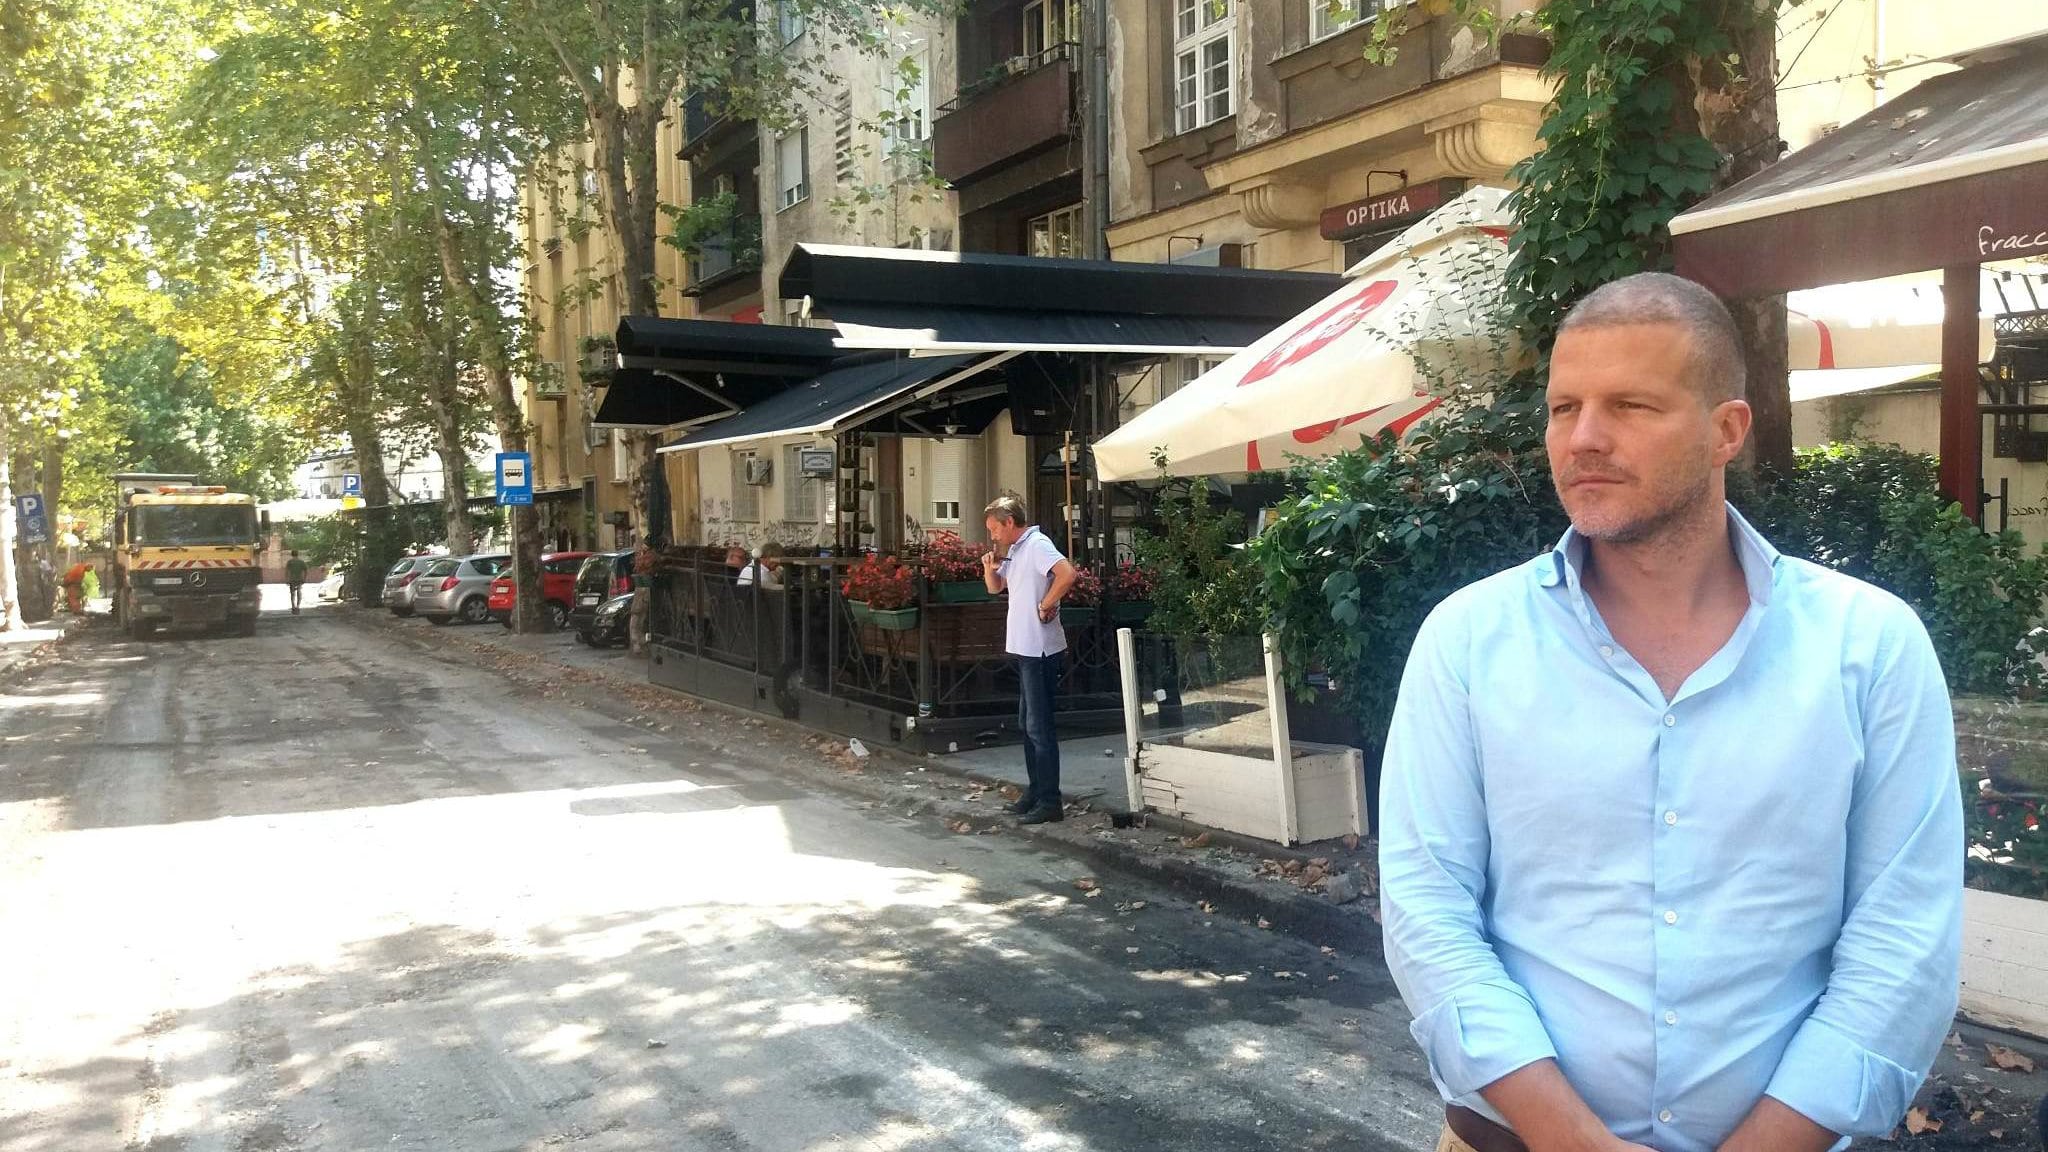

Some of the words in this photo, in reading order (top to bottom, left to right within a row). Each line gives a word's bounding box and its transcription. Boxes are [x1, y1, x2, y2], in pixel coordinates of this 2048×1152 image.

[1346, 195, 1410, 226] OPTIKA
[346, 476, 357, 489] P
[22, 497, 37, 515] P
